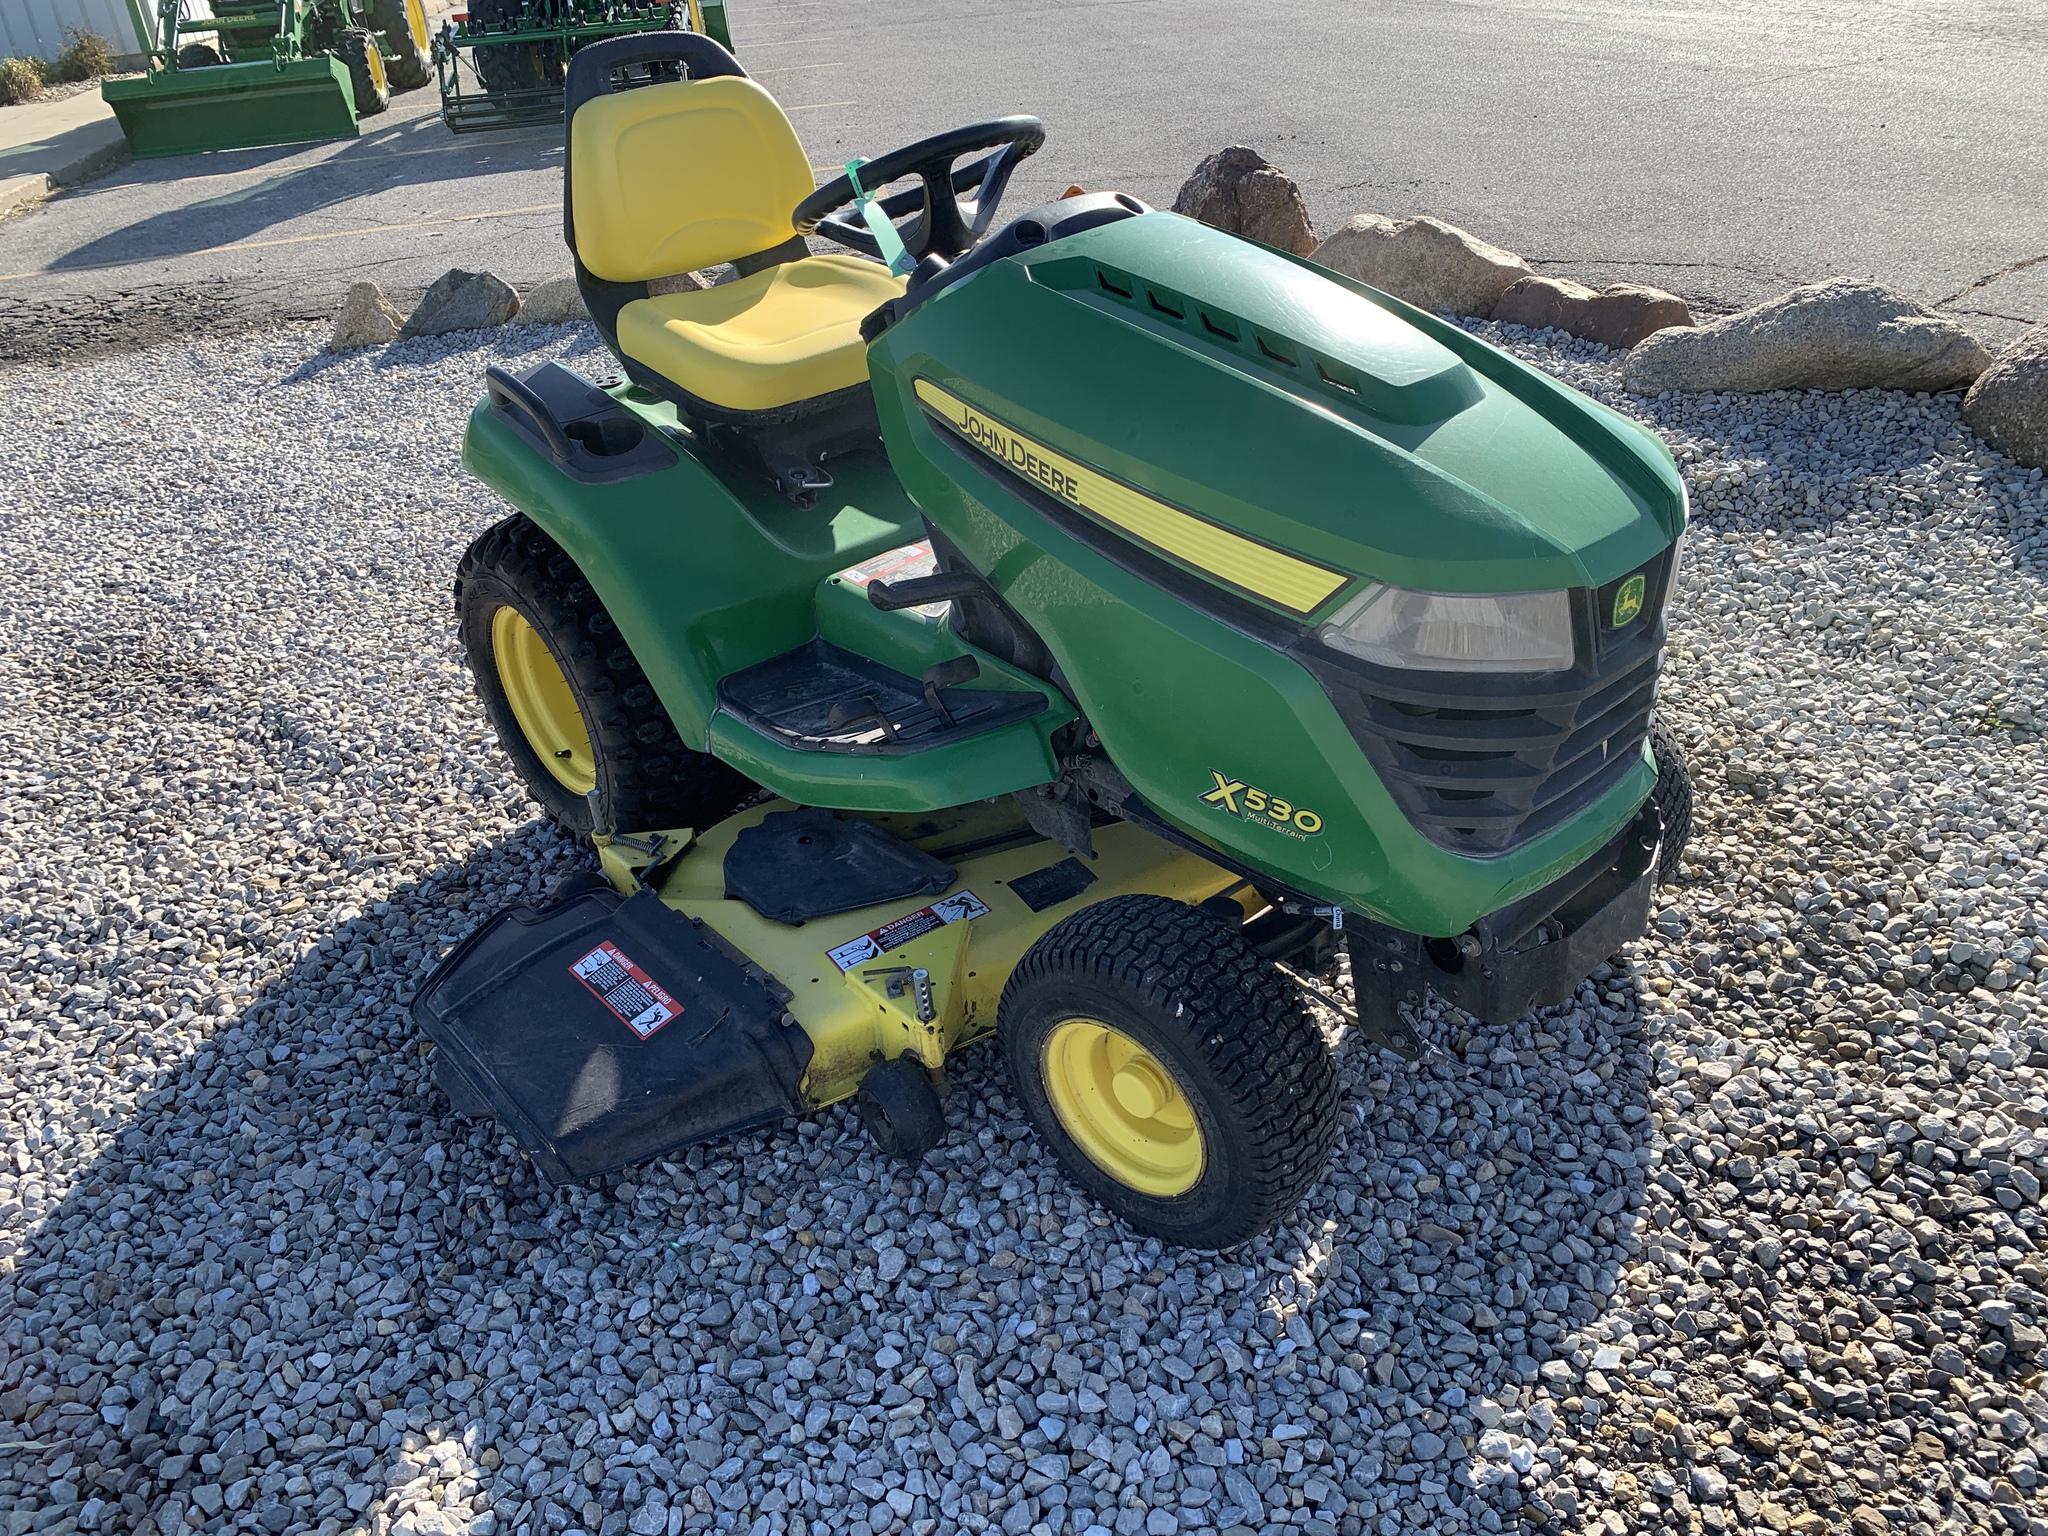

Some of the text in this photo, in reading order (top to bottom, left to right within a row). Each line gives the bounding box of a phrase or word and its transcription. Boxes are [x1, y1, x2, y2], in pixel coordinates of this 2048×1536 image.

[202, 17, 224, 25] JOHN
[959, 407, 1078, 502] JOHN DEERE
[1199, 768, 1323, 834] X530
[1247, 811, 1305, 840] Multi-Terrain
[887, 911, 925, 931] DANGER
[612, 951, 634, 971] DANGER
[648, 984, 672, 1005] PELIGRO
